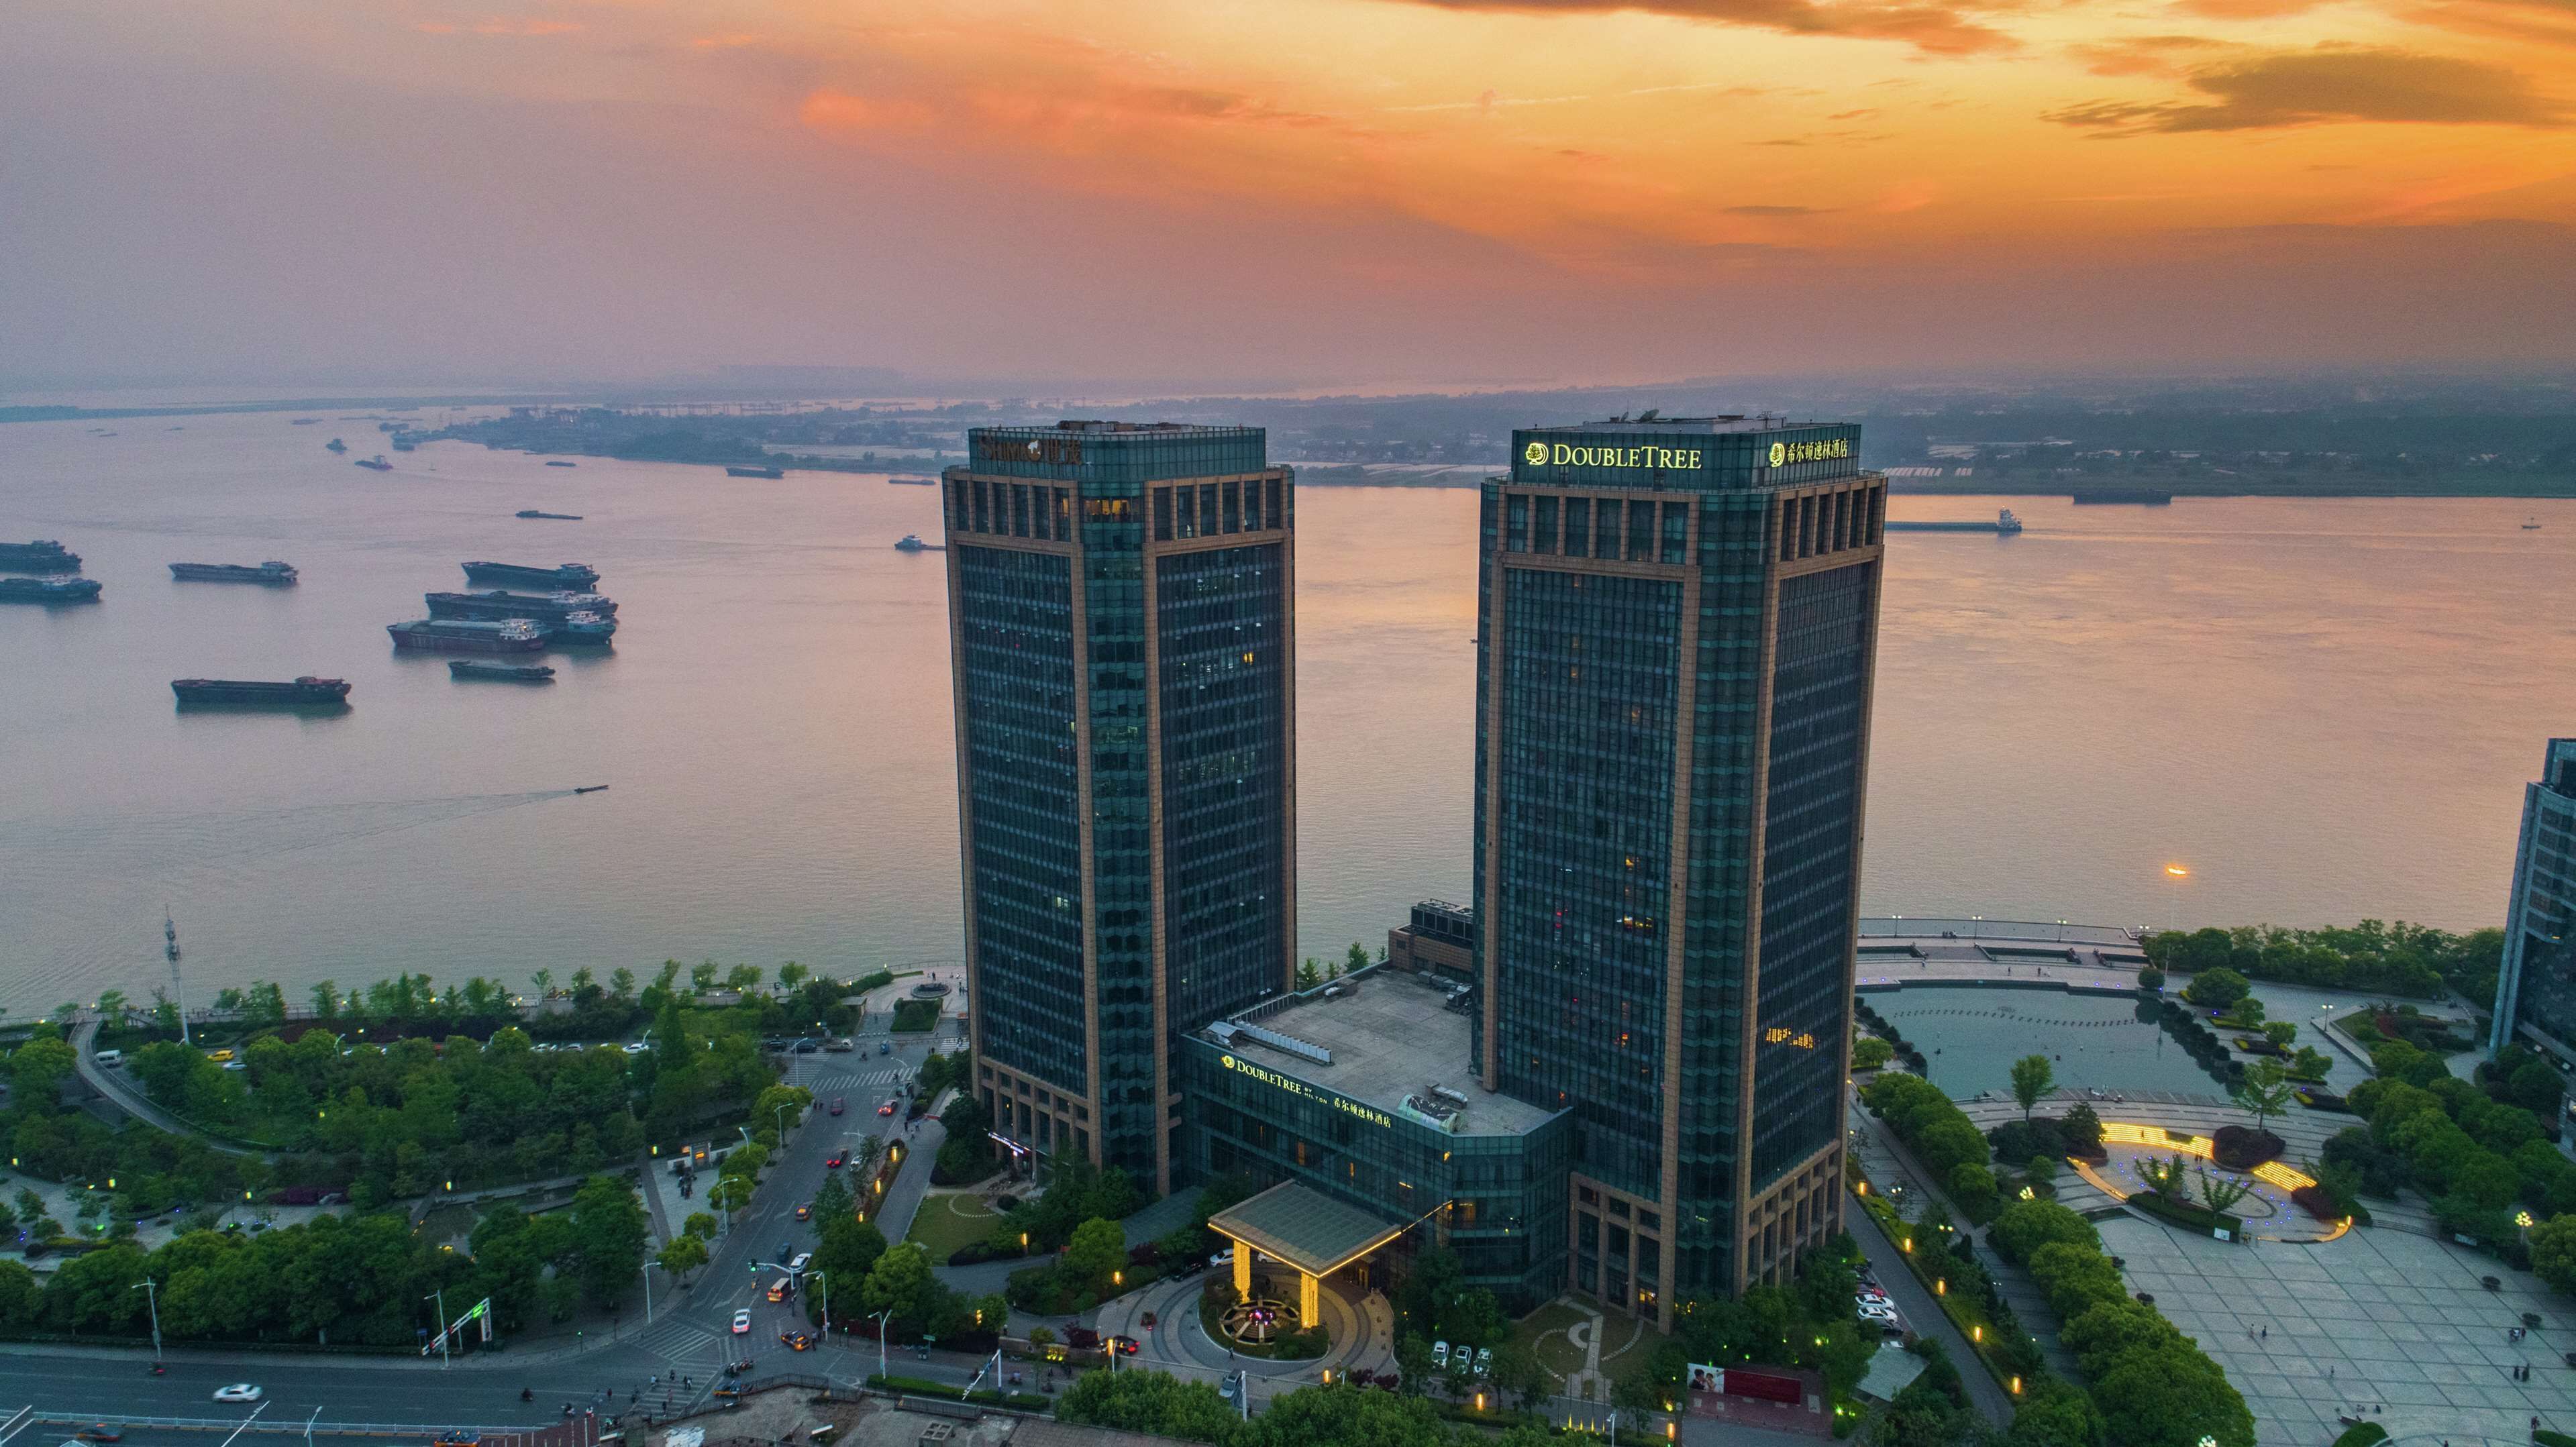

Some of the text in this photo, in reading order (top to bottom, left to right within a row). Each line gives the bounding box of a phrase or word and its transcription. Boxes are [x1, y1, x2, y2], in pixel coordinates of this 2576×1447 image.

[1553, 444, 1701, 469] DOUBLETREE
[1788, 438, 1848, 463] 希尔顿逸林酒店
[1237, 1060, 1301, 1094] DOUBLETREE
[1304, 1093, 1327, 1104] HILTON
[1334, 1097, 1390, 1128] 希尔顿逸林酒店
